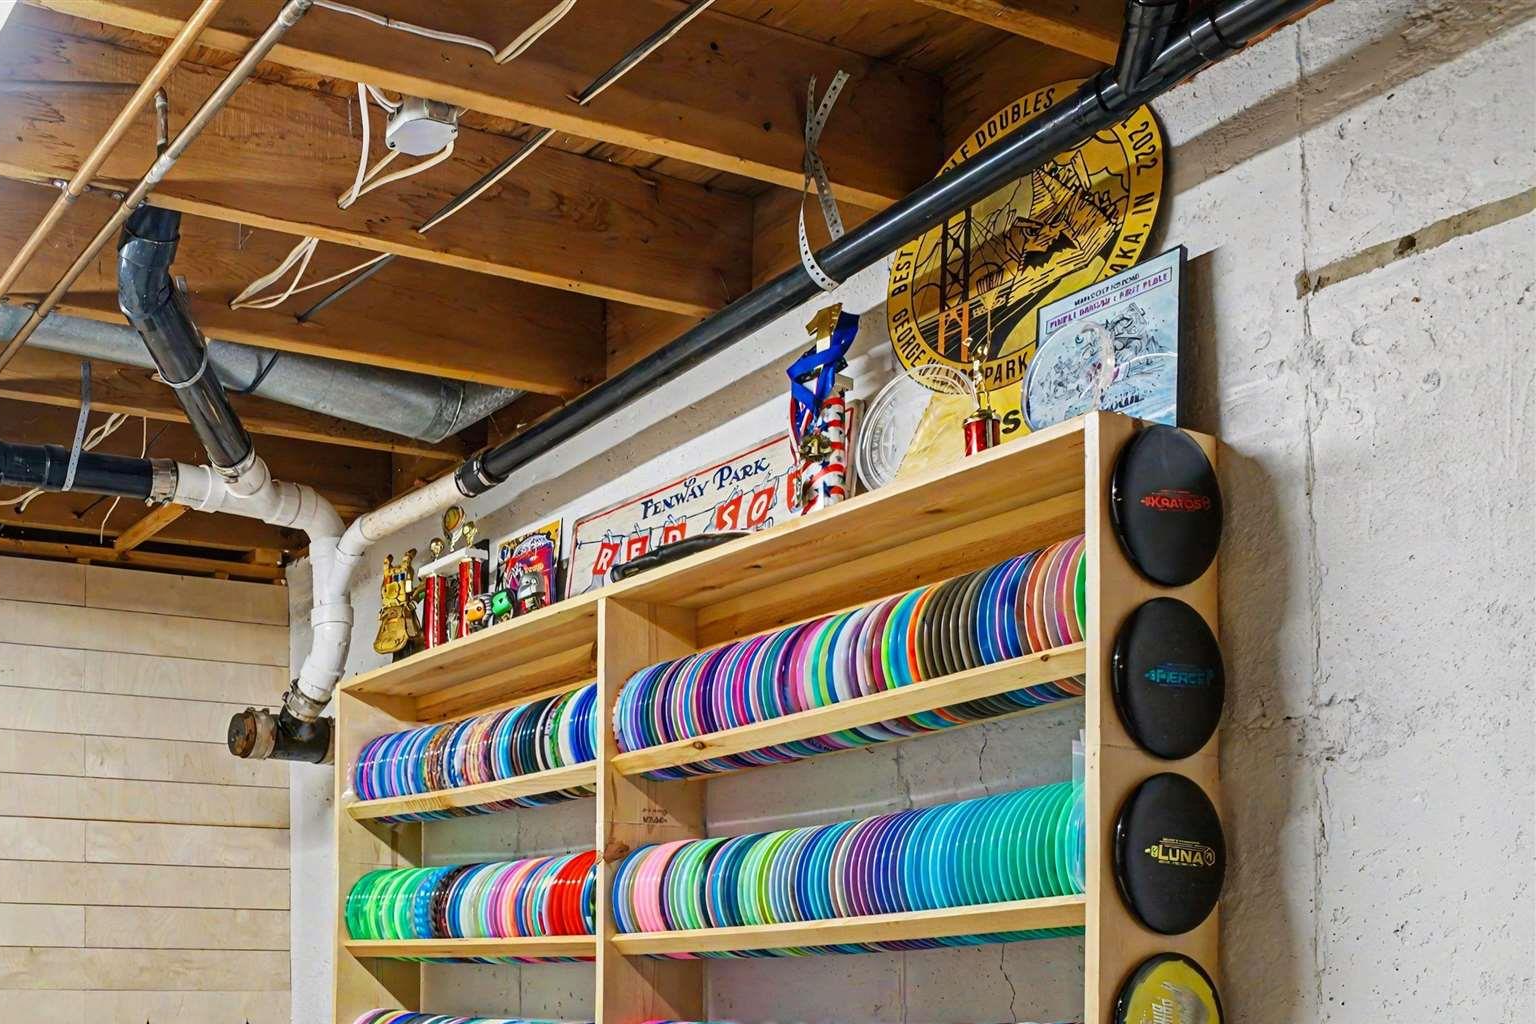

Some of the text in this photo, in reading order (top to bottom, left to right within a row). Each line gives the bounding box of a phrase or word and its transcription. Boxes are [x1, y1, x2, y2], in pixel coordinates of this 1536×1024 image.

[891, 250, 913, 297] BEST
[975, 88, 1056, 148] DOUBLES
[1128, 121, 1158, 176] 2022
[893, 308, 926, 367] GEORGE
[985, 352, 1028, 384] PARK
[1134, 193, 1154, 218] IN
[1158, 844, 1204, 865] LUNA
